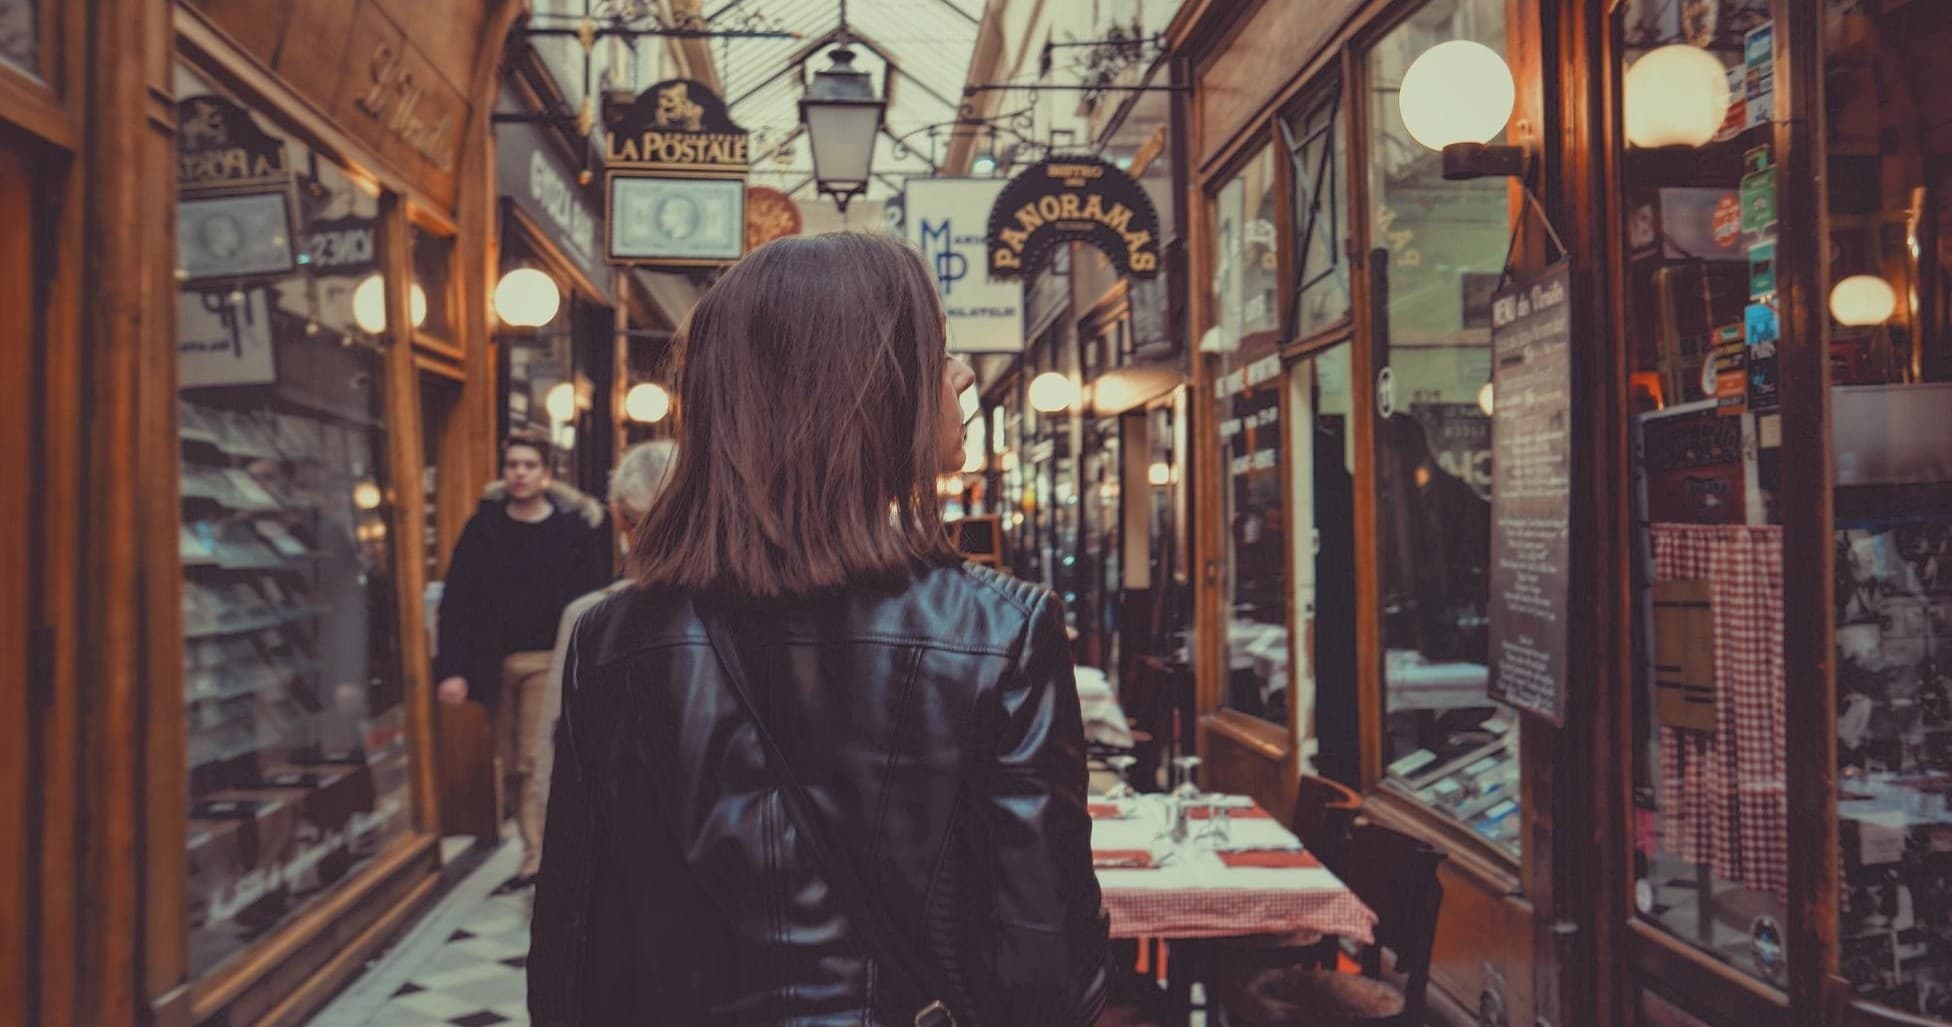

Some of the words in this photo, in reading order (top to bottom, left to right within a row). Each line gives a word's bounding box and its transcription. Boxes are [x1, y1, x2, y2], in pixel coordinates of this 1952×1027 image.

[604, 130, 640, 161] LA
[642, 131, 749, 164] POSTALE
[1046, 163, 1104, 178] BISTRO
[993, 192, 1157, 272] PANORAMAS
